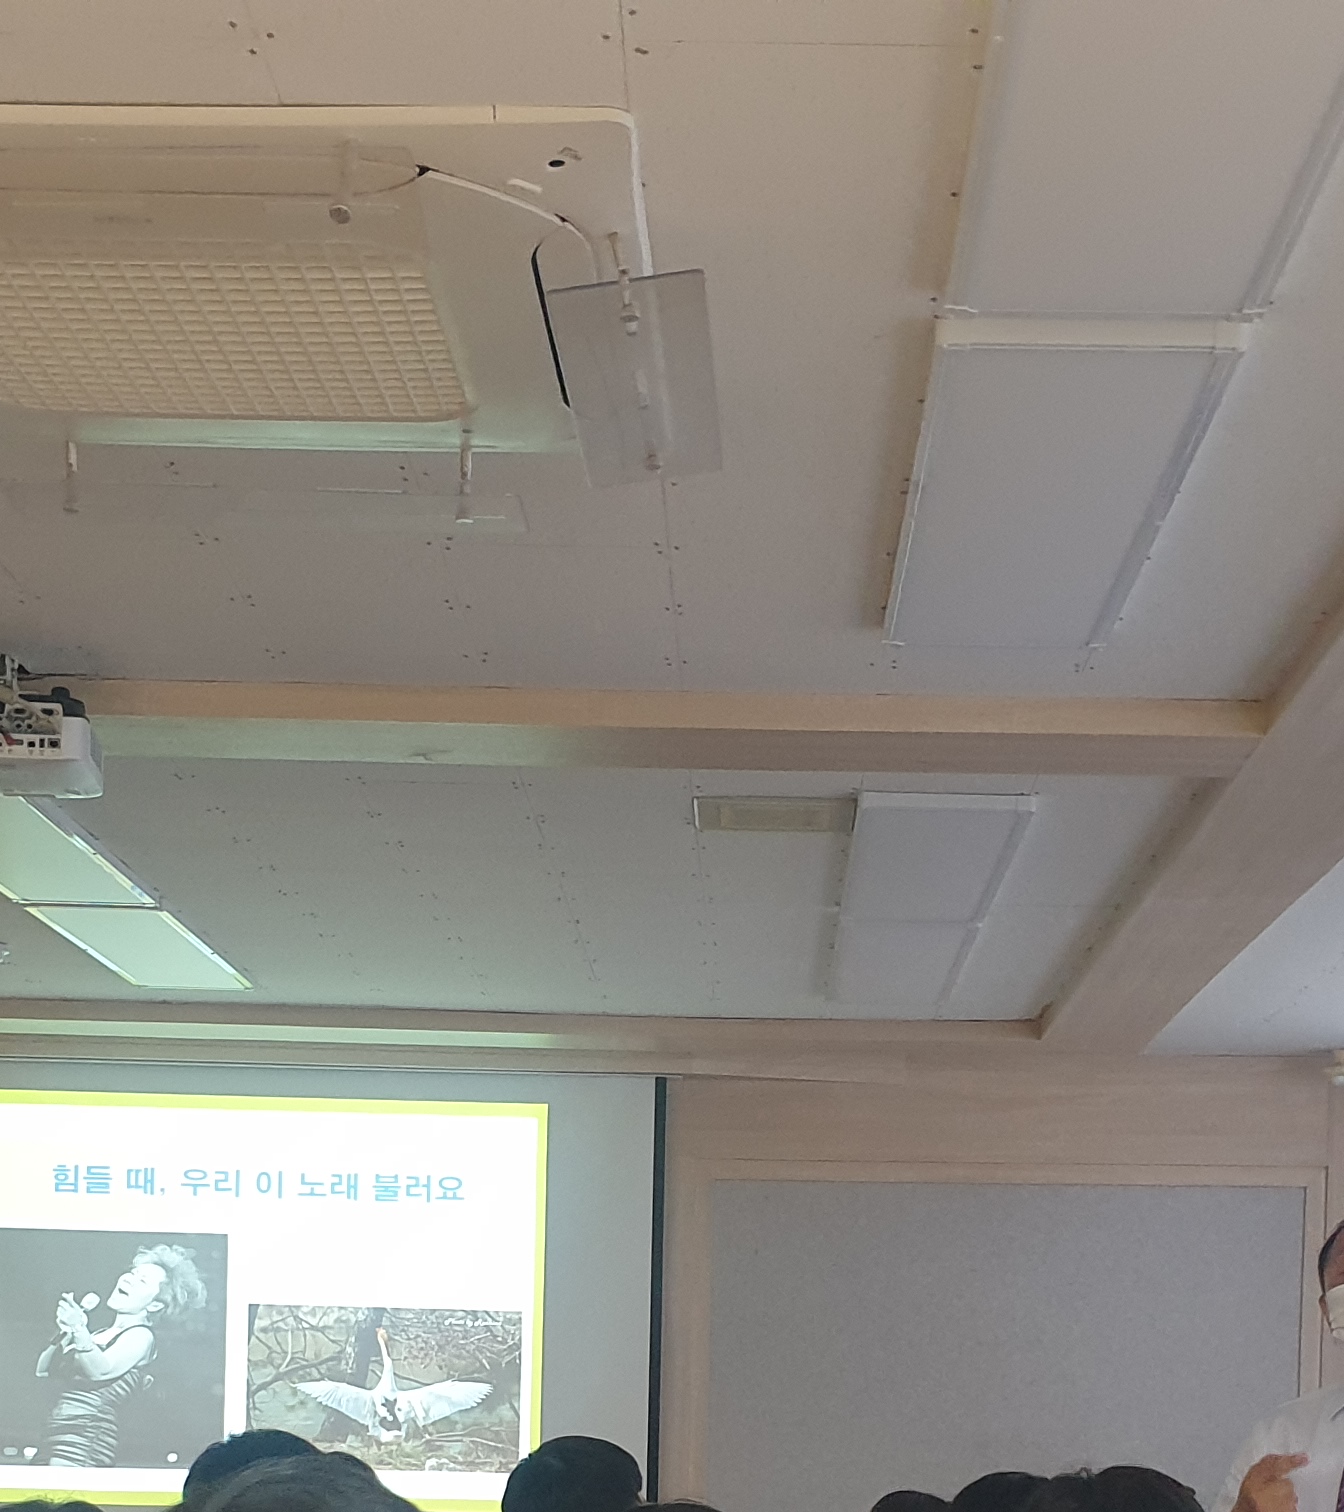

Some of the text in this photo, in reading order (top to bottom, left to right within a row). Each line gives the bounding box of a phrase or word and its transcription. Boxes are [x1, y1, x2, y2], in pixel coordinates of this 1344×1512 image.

[52, 1164, 466, 1203] 힘들 때, 우리 이 노래 불러요
